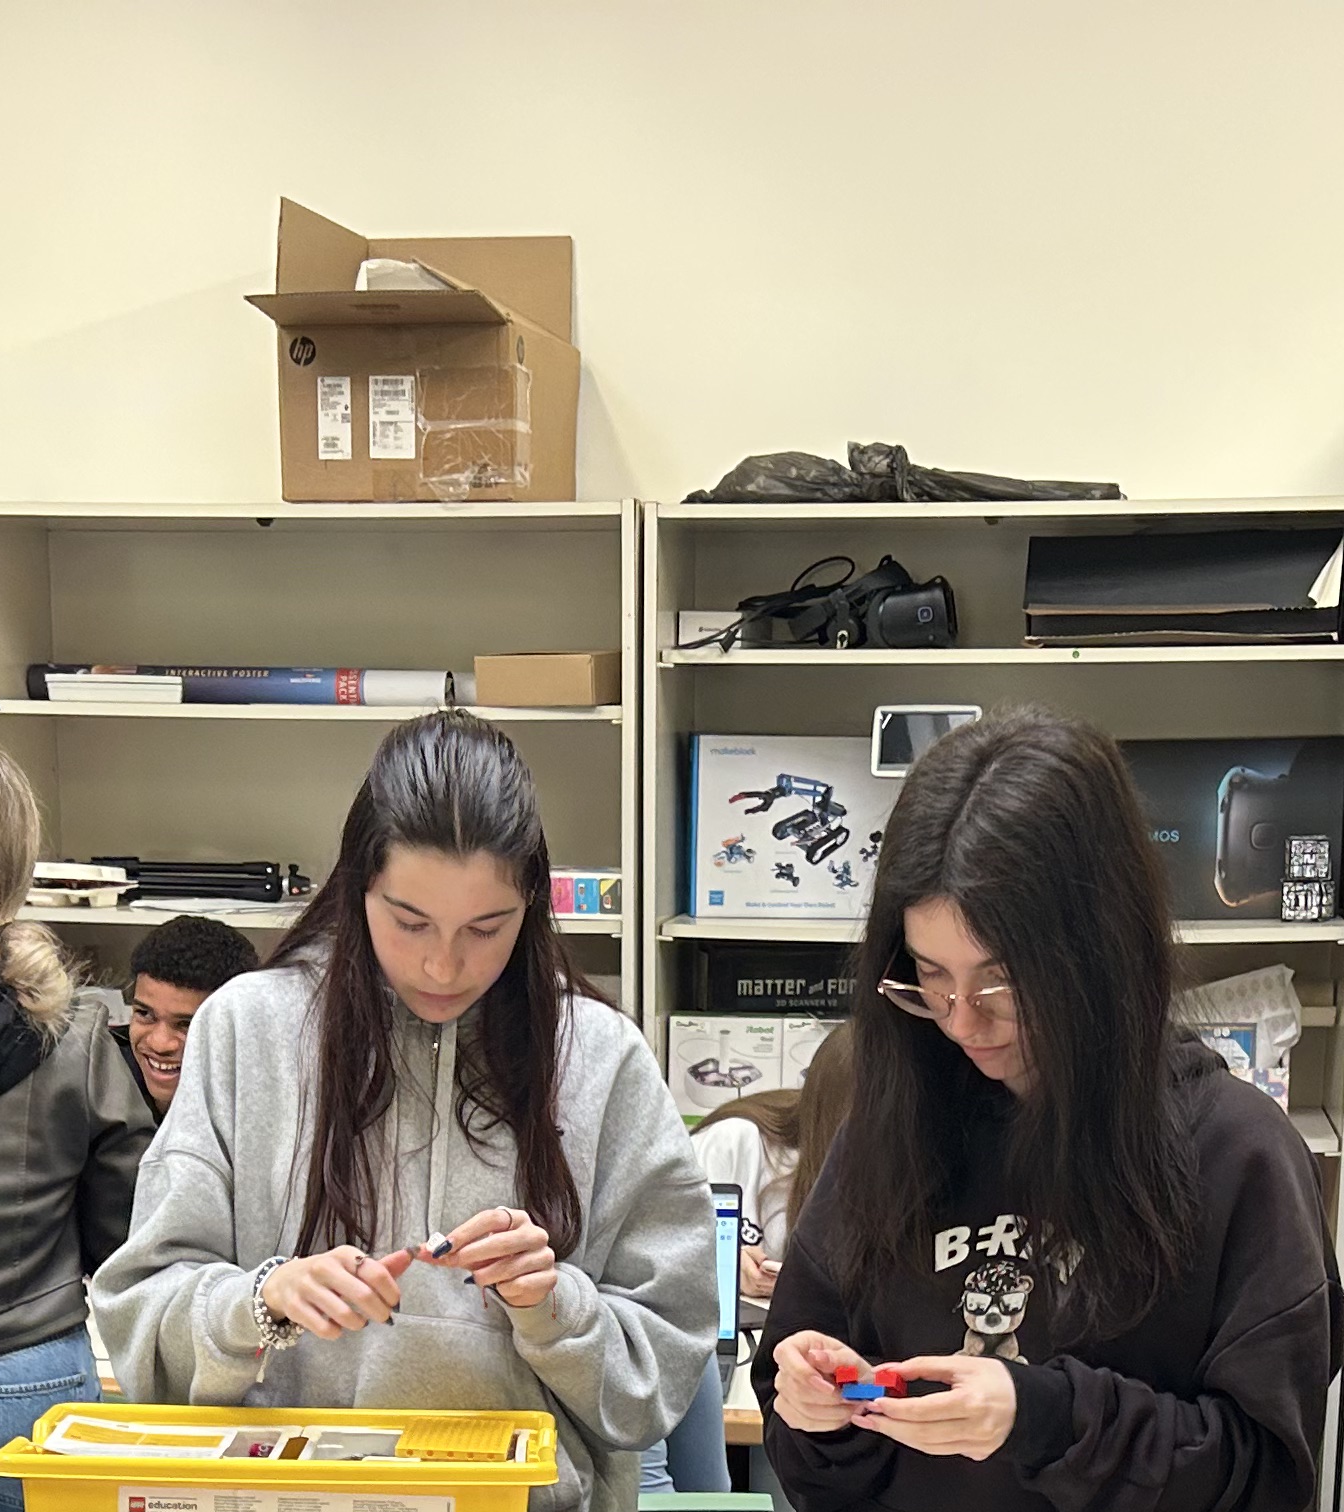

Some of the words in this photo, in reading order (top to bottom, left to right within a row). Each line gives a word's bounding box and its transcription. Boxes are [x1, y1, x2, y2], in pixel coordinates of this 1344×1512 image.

[290, 336, 316, 367] hp
[165, 668, 228, 678] INTERACTIVE
[231, 669, 270, 679] POSTER
[338, 675, 348, 701] PACK
[788, 999, 826, 1007] SCANNER
[148, 1501, 198, 1511] education
